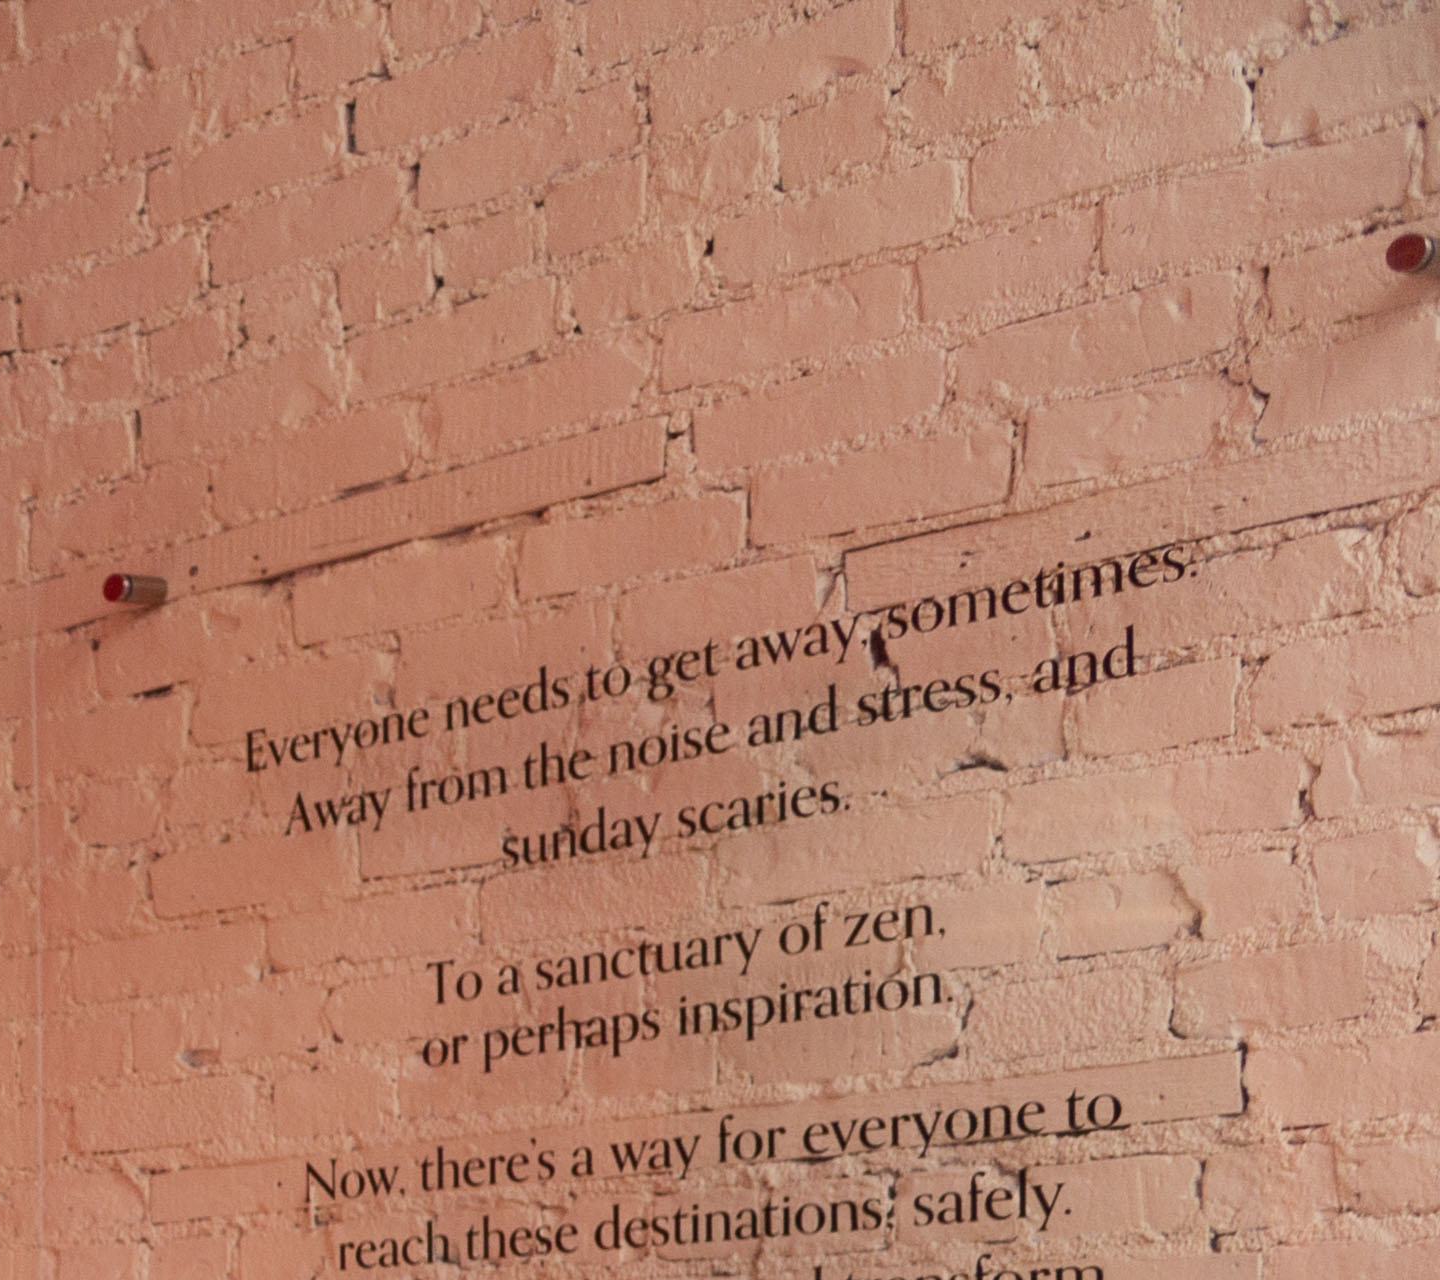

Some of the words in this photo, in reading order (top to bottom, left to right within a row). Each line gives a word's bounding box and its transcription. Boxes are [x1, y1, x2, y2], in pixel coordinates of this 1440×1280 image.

[245, 706, 430, 772] Everyone
[445, 666, 570, 732] needs
[585, 661, 632, 703] to
[647, 637, 719, 700] get
[736, 613, 870, 673] away,
[887, 543, 1198, 640] sometimes.
[284, 786, 392, 836] Away
[407, 766, 508, 812] from
[524, 741, 593, 790] the
[609, 720, 730, 773] noise
[748, 684, 838, 747] and
[857, 668, 1013, 726] stress,
[1033, 625, 1137, 694] and
[502, 807, 661, 868] sunday
[678, 779, 850, 839] scaries.
[427, 960, 482, 1005] To
[498, 964, 520, 996] a
[536, 927, 762, 990] sanctuary
[780, 902, 830, 955] of
[844, 904, 946, 947] zen,
[422, 1035, 468, 1067] or
[483, 1006, 661, 1073] perhaps
[680, 969, 953, 1040] inspiration.
[421, 1139, 556, 1191] there's
[571, 1145, 594, 1176] a
[611, 1135, 700, 1180] way
[719, 1115, 785, 1163] for
[803, 1099, 1045, 1158] everyone
[1066, 1089, 1121, 1131] to
[339, 1220, 450, 1270] reach
[466, 1215, 578, 1261] these
[914, 1168, 1071, 1231] safely.
